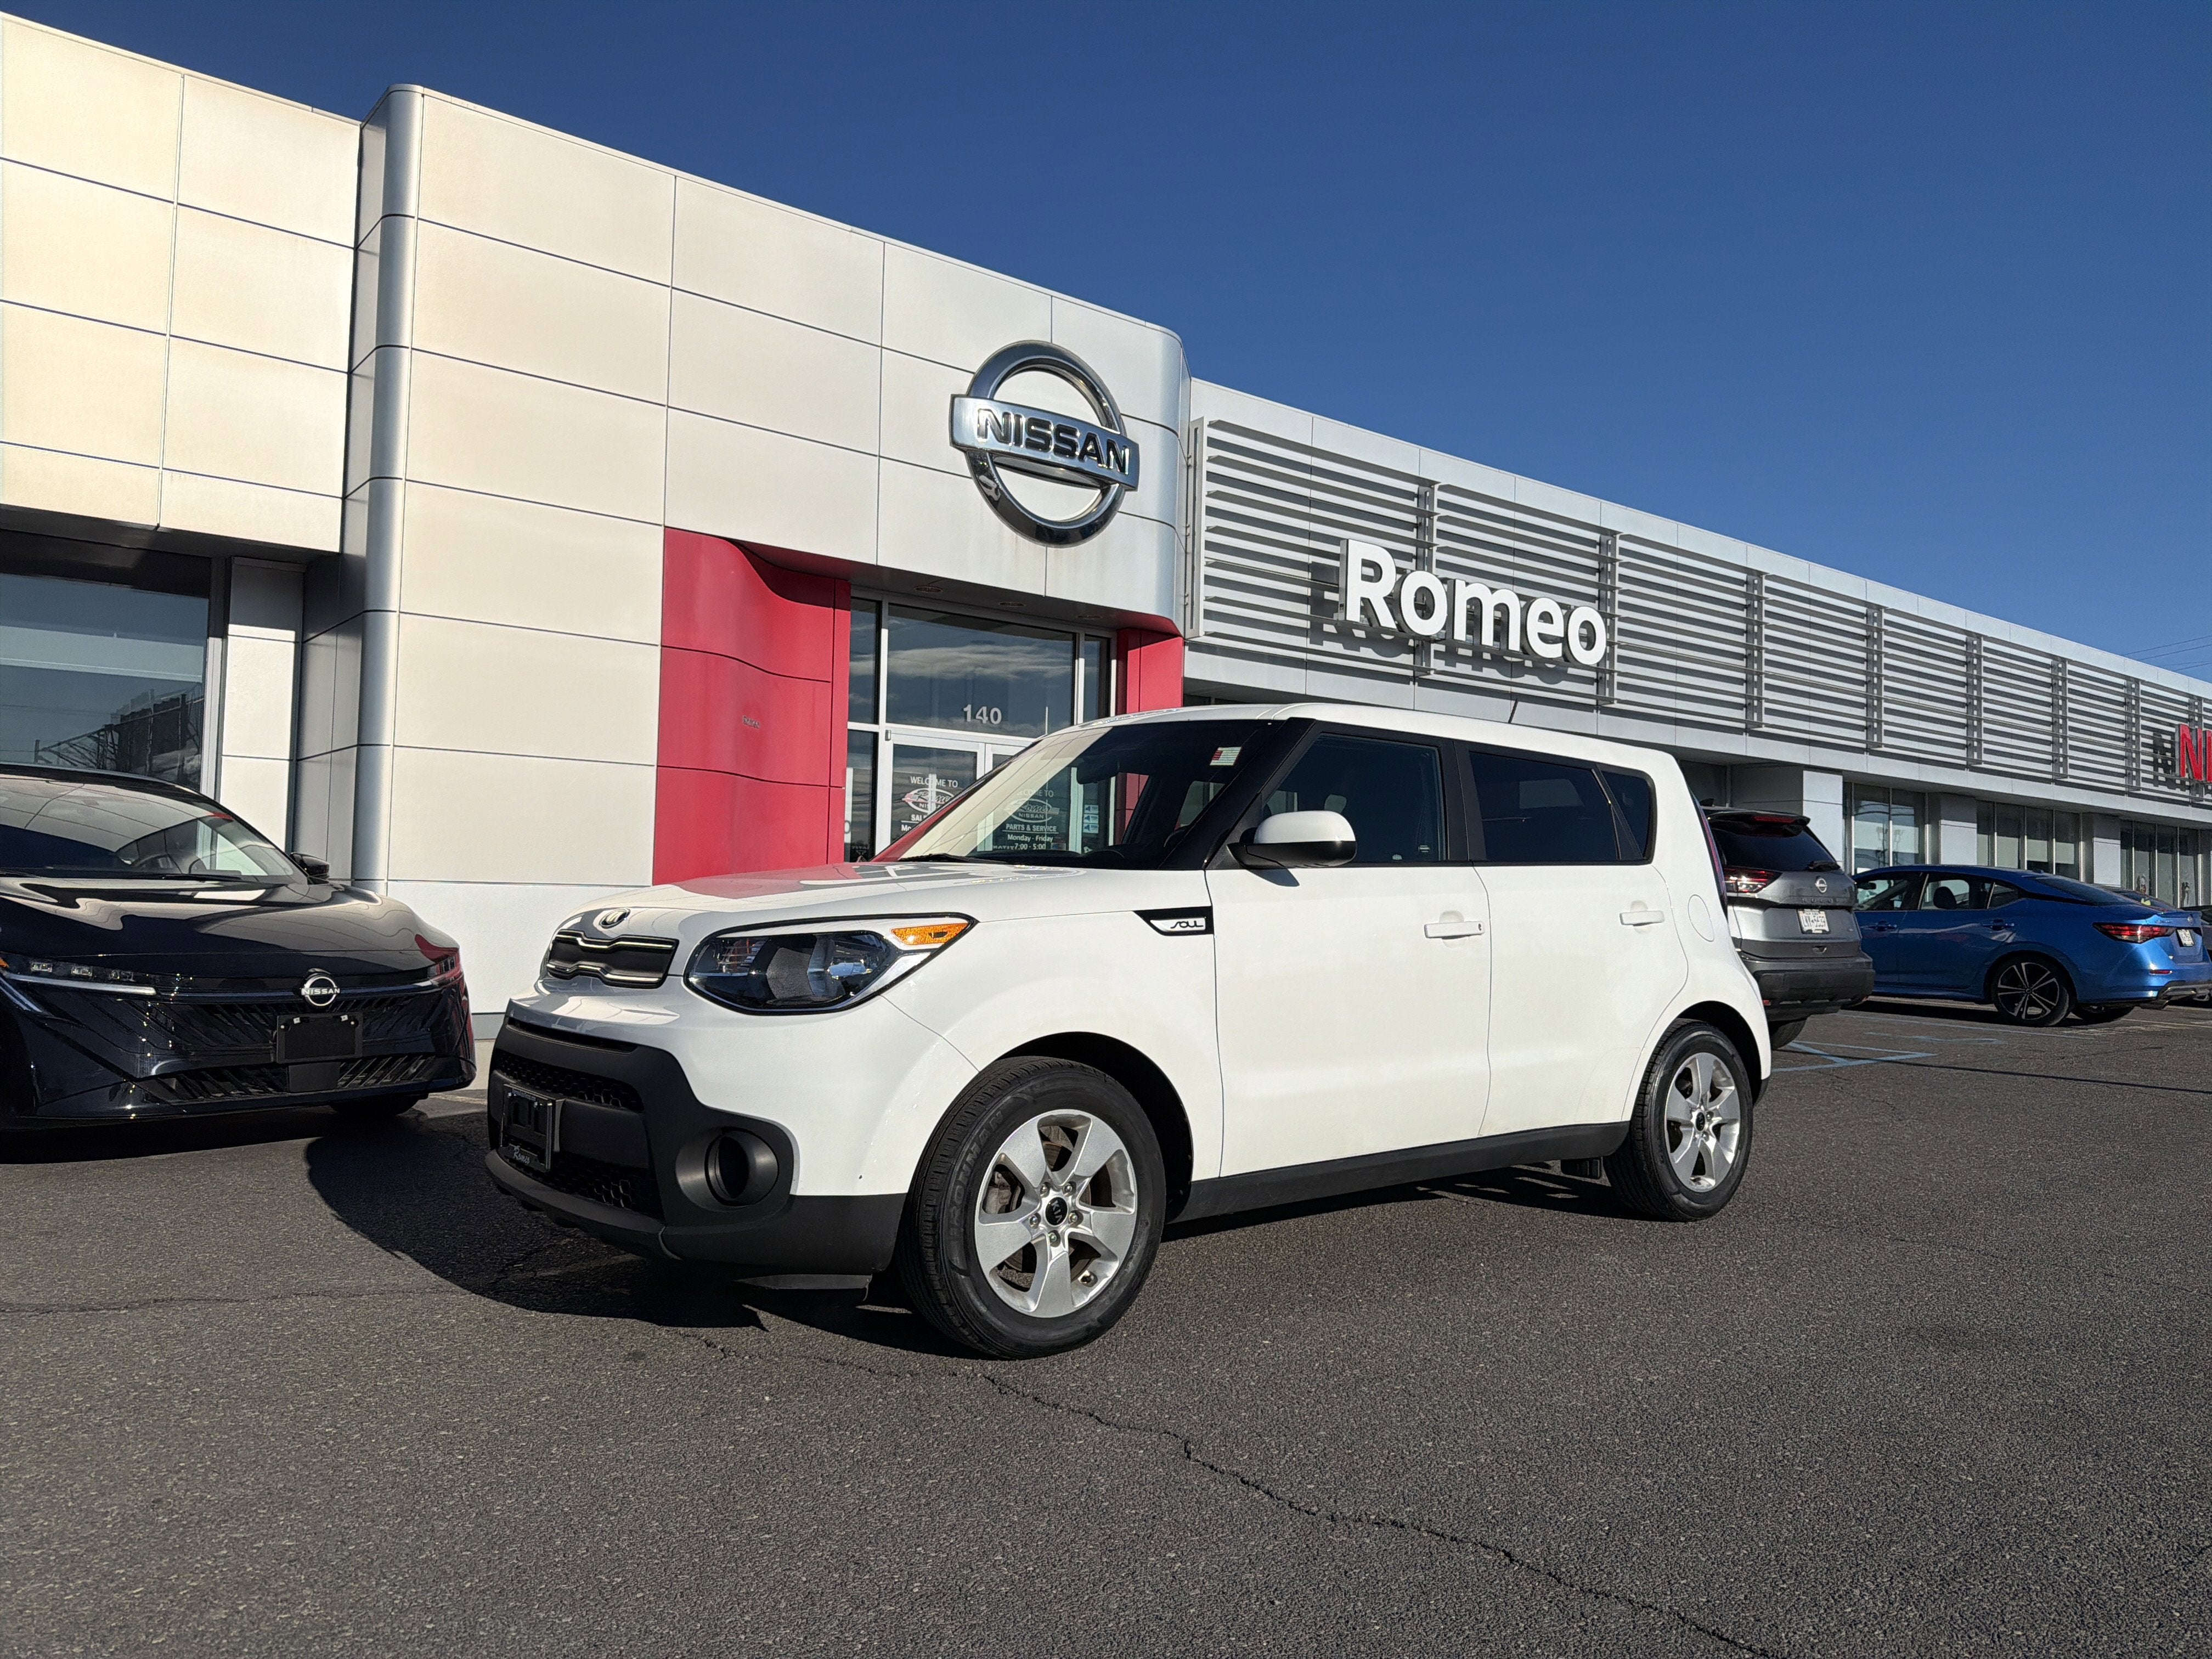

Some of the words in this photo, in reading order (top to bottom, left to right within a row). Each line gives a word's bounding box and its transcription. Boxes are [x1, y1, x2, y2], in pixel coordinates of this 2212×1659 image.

[976, 407, 1130, 476] NISSAN
[1341, 538, 1607, 665] Romeo
[963, 704, 1002, 724] 140
[910, 776, 946, 787] WELCME
[947, 780, 958, 788] TO
[1044, 789, 1054, 798] TO
[1032, 824, 1057, 832] SERVICE
[1007, 834, 1031, 843] Monday
[1035, 834, 1053, 843] Friday
[1051, 1199, 1063, 1223] KIA
